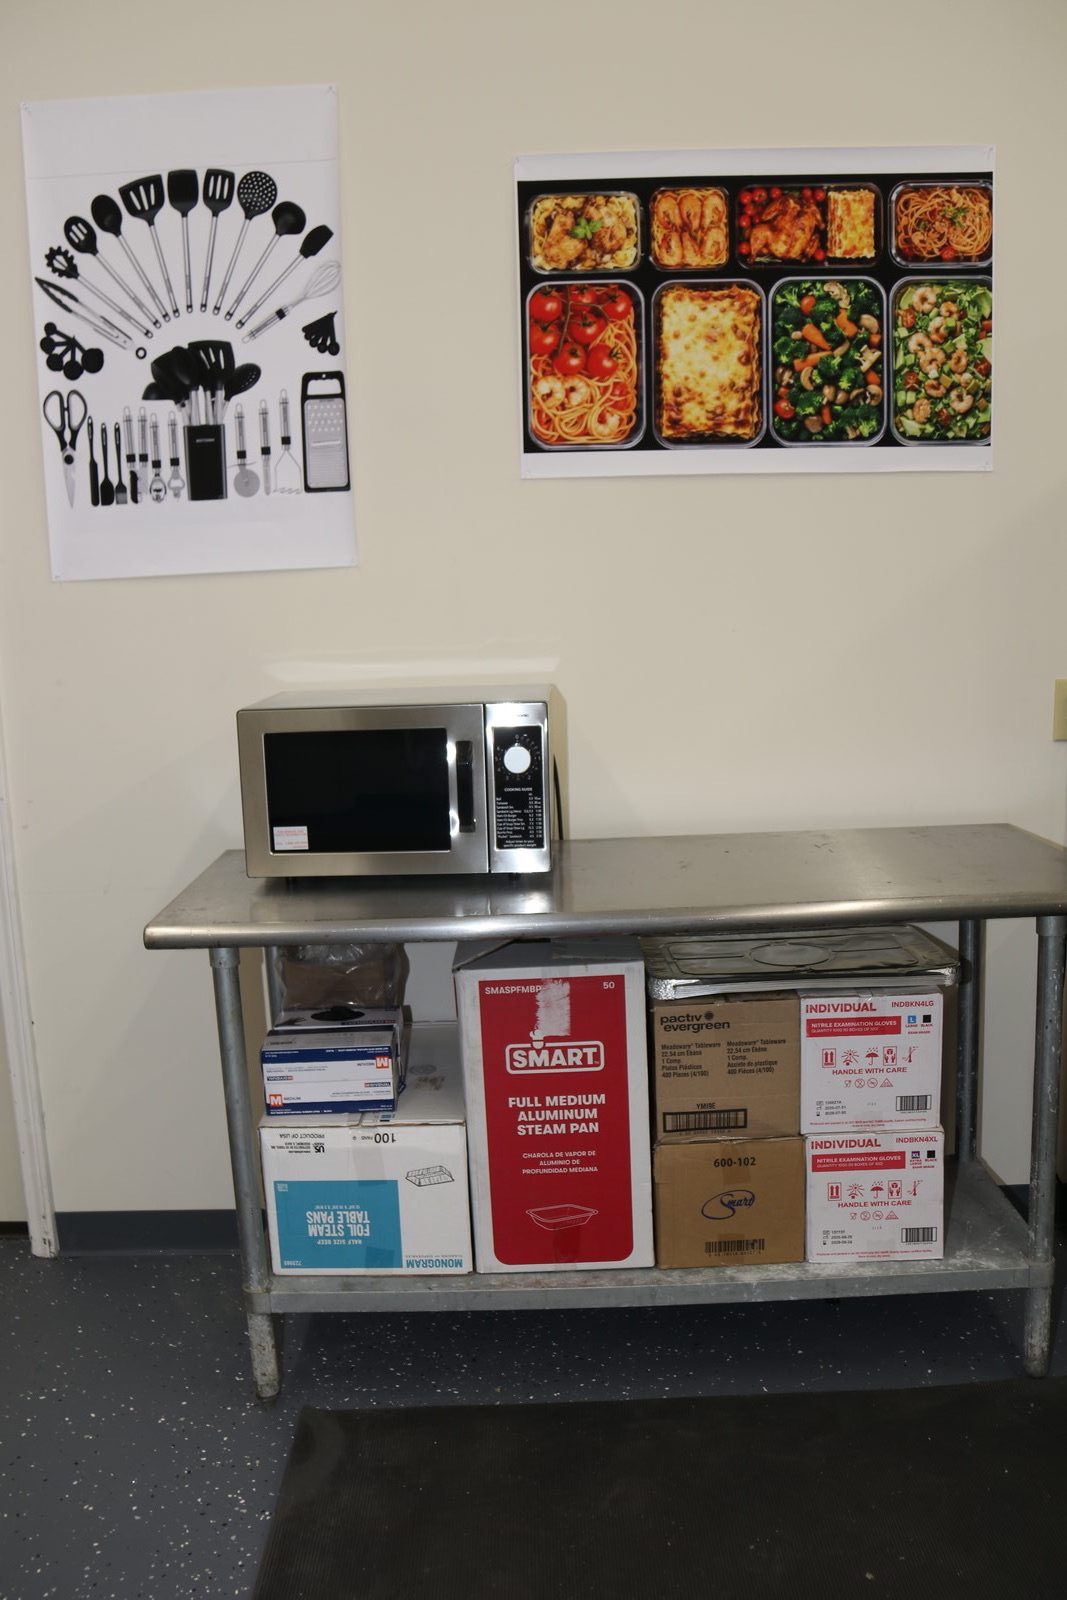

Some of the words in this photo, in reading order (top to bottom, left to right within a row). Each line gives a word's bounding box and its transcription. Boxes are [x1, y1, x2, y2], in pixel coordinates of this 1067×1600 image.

[603, 982, 615, 990] 50
[806, 1003, 876, 1014] INDIVIDUAL
[660, 1013, 702, 1026] pactiv
[664, 1021, 730, 1034] evergreen
[512, 1048, 597, 1068] SMART
[508, 1097, 542, 1108] FULL
[545, 1094, 606, 1106] MEDIUM
[518, 1108, 597, 1121] ALUMINUM
[517, 1124, 566, 1136] STEAM
[570, 1122, 599, 1133] PAN
[374, 1133, 396, 1144] 100
[811, 1138, 881, 1150] INDIVIDUAL
[714, 1157, 756, 1167] 600-102
[306, 1211, 334, 1224] PANS
[337, 1211, 370, 1223] TABLE
[308, 1224, 344, 1236] STEAM
[347, 1224, 370, 1236] FOIL
[406, 1259, 463, 1268] MONOGRAM
